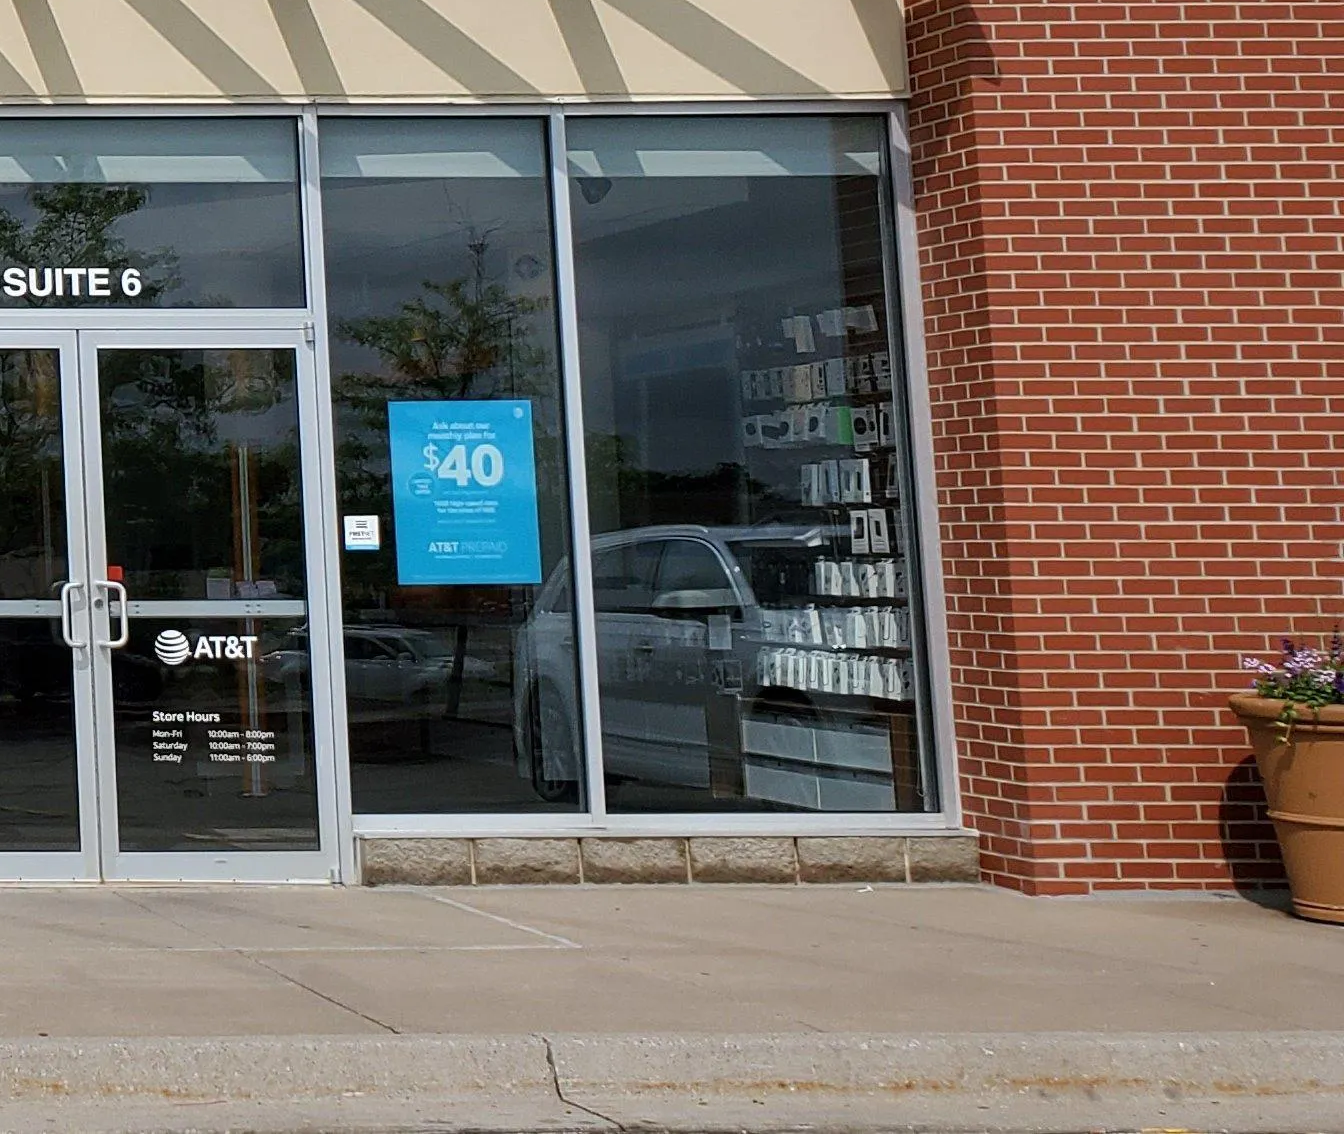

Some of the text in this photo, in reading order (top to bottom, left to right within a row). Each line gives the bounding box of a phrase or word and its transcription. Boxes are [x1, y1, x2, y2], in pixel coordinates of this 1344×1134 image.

[2, 267, 143, 297] SUITE 6
[423, 443, 504, 487] $40
[428, 541, 459, 553] AT&T
[193, 635, 258, 659] AT&T
[152, 711, 221, 722] Store Hours
[152, 730, 183, 738] Mon-Fri
[207, 730, 240, 738] 10:00am
[152, 741, 188, 752] Saturday
[208, 741, 241, 750] 10:00am
[246, 741, 275, 751] 7:00pm
[153, 753, 182, 763] Sunday
[209, 753, 241, 762] 11:00am
[246, 753, 275, 763] 6:00pm
